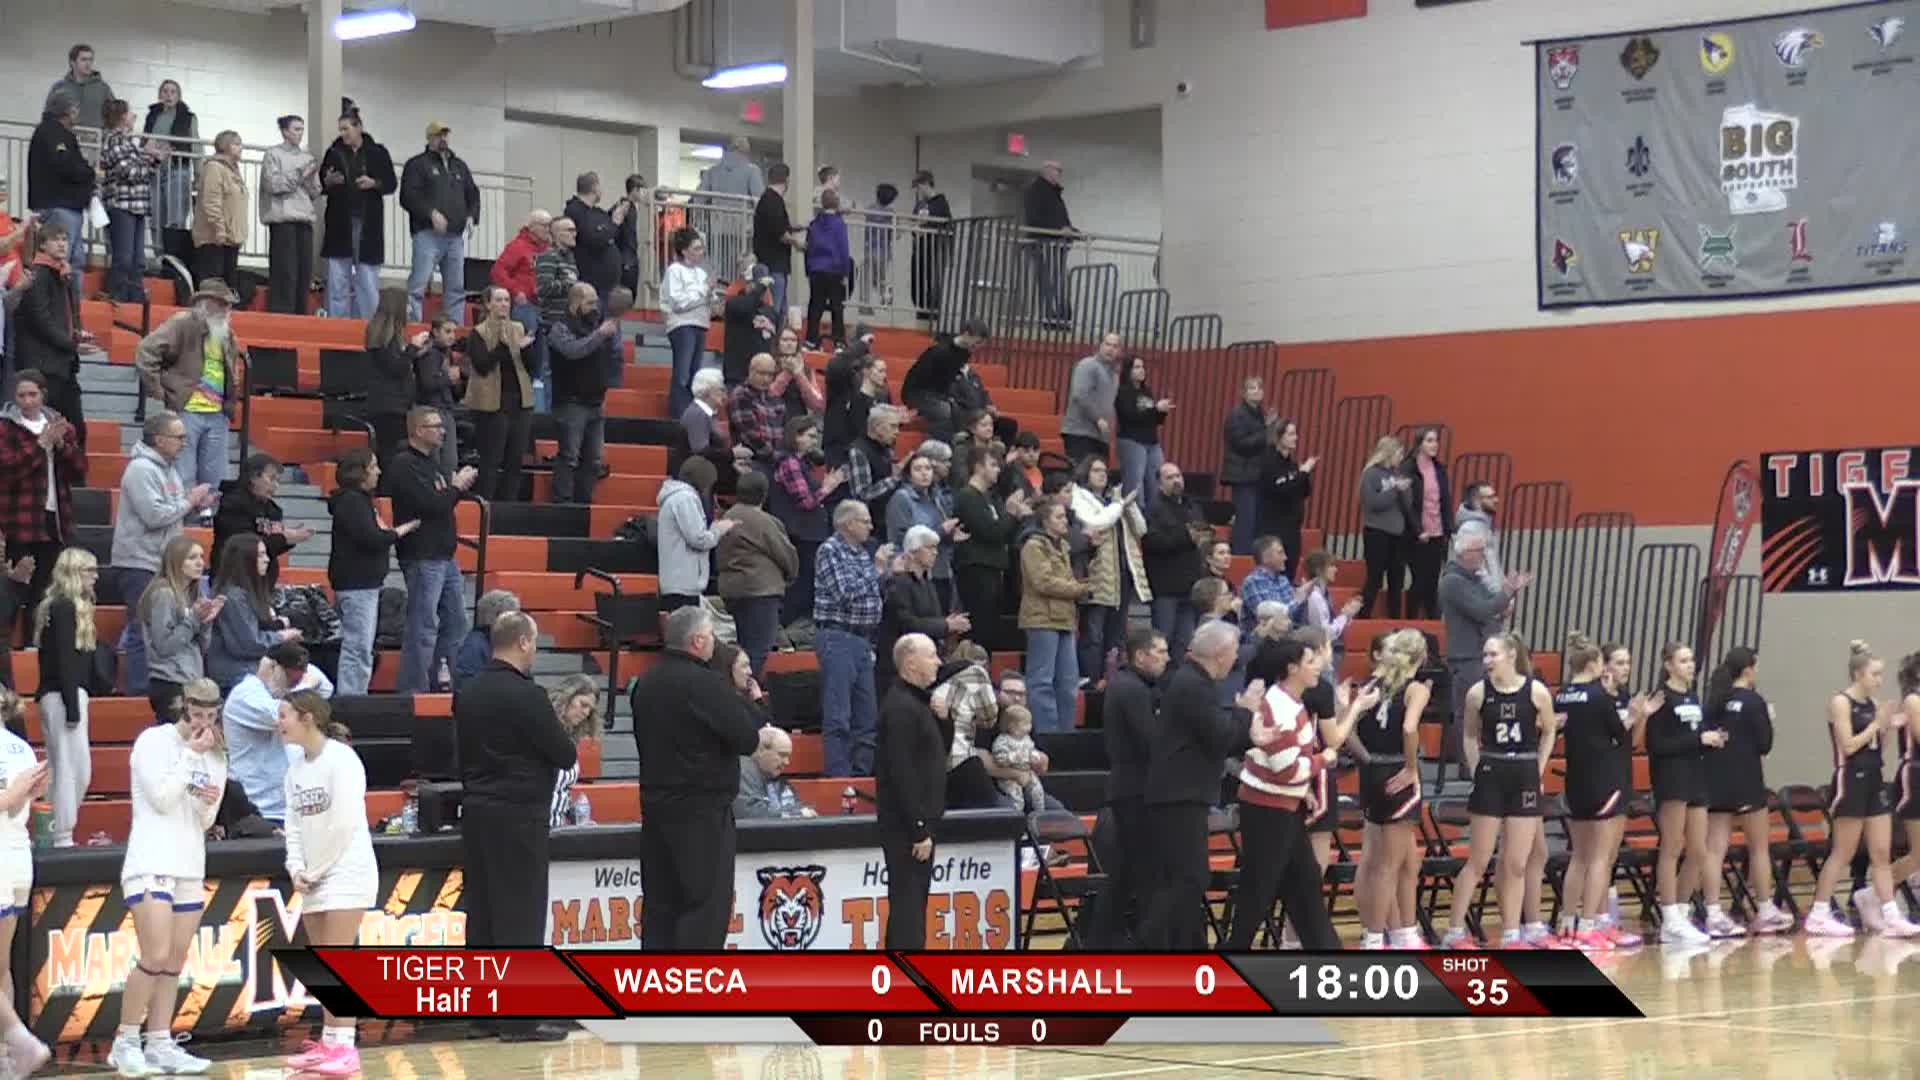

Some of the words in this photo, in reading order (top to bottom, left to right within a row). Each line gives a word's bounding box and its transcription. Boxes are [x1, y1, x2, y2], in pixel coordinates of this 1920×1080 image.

[1722, 120, 1793, 160] BIG
[1722, 158, 1793, 181] SOUTH
[1843, 481, 1920, 586] M
[1376, 699, 1389, 729] 4
[1496, 722, 1522, 744] 24
[594, 867, 641, 888] Welc
[931, 857, 954, 882] of
[959, 857, 991, 880] the
[842, 889, 1011, 950] TIERS
[48, 926, 243, 988] MARALL
